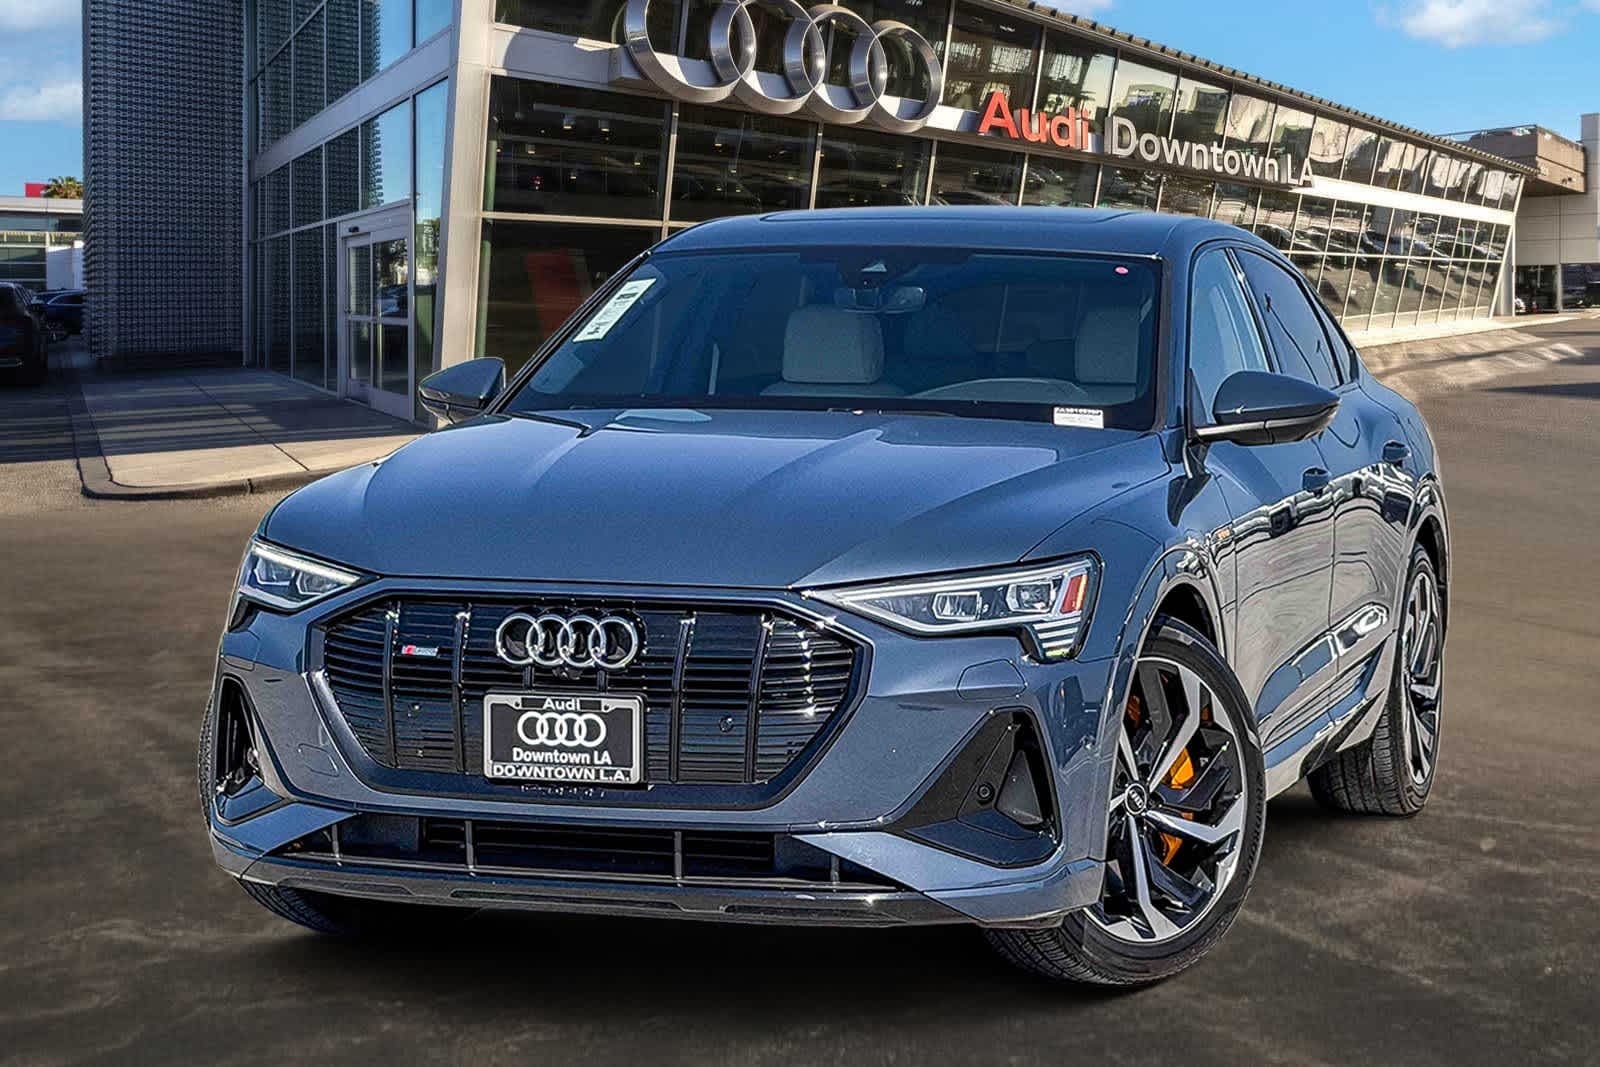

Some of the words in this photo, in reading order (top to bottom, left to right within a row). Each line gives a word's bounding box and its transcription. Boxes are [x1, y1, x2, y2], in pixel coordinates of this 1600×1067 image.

[977, 91, 1089, 151] Audi
[1105, 115, 1280, 181] Downtown
[1286, 152, 1316, 188] LA
[542, 697, 581, 711] Audi
[512, 747, 590, 764] Downtown
[594, 750, 612, 765] LA
[493, 764, 595, 780] DOWNTOWN
[600, 769, 630, 782] L.A.
